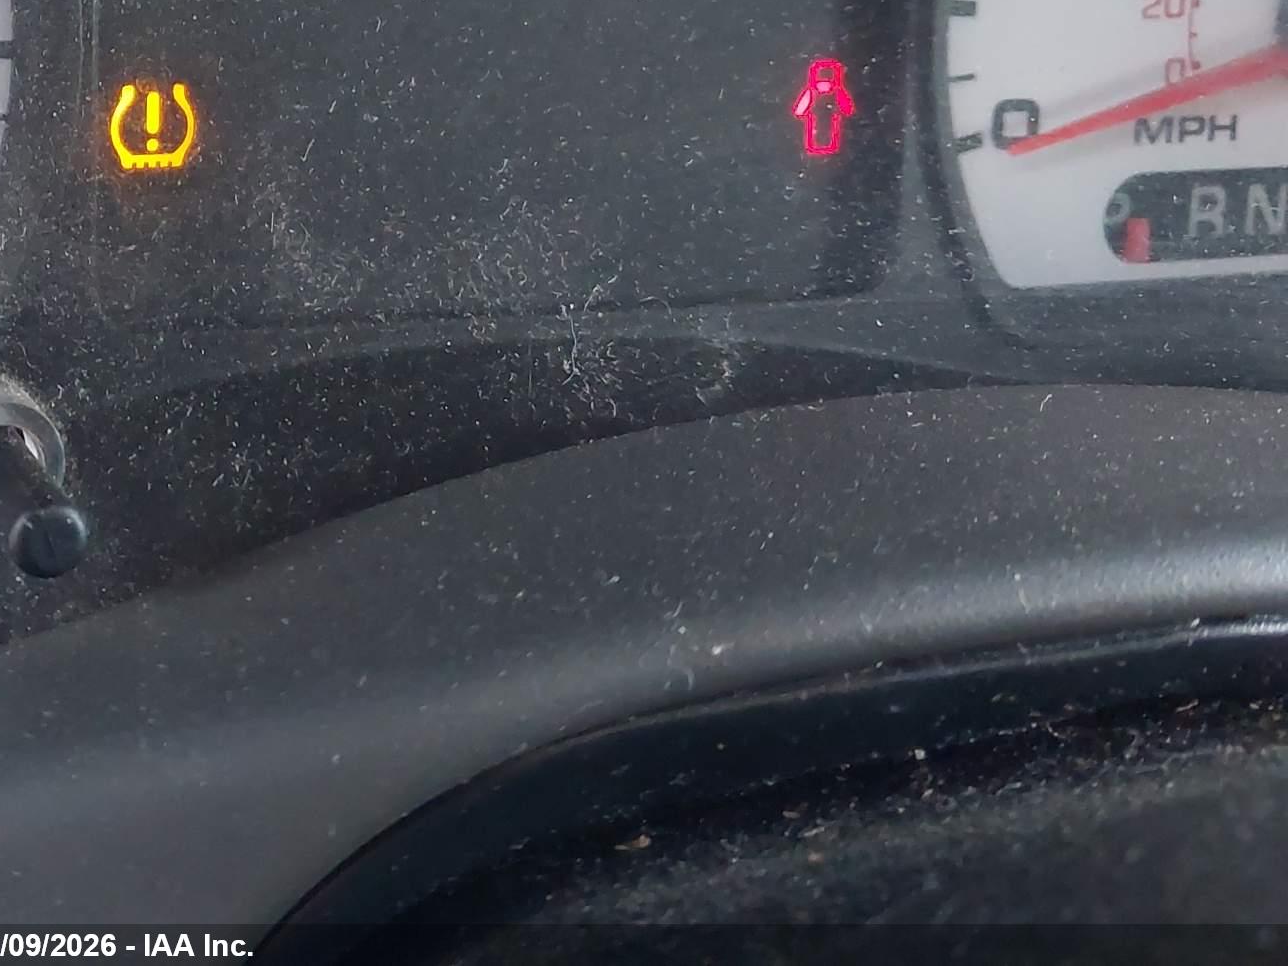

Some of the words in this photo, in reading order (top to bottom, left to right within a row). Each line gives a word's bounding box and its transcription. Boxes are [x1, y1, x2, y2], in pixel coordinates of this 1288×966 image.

[1164, 57, 1186, 85] 0
[992, 98, 1041, 151] 0
[1133, 114, 1238, 145] MPH
[1188, 185, 1227, 237] R
[1245, 183, 1288, 235] N
